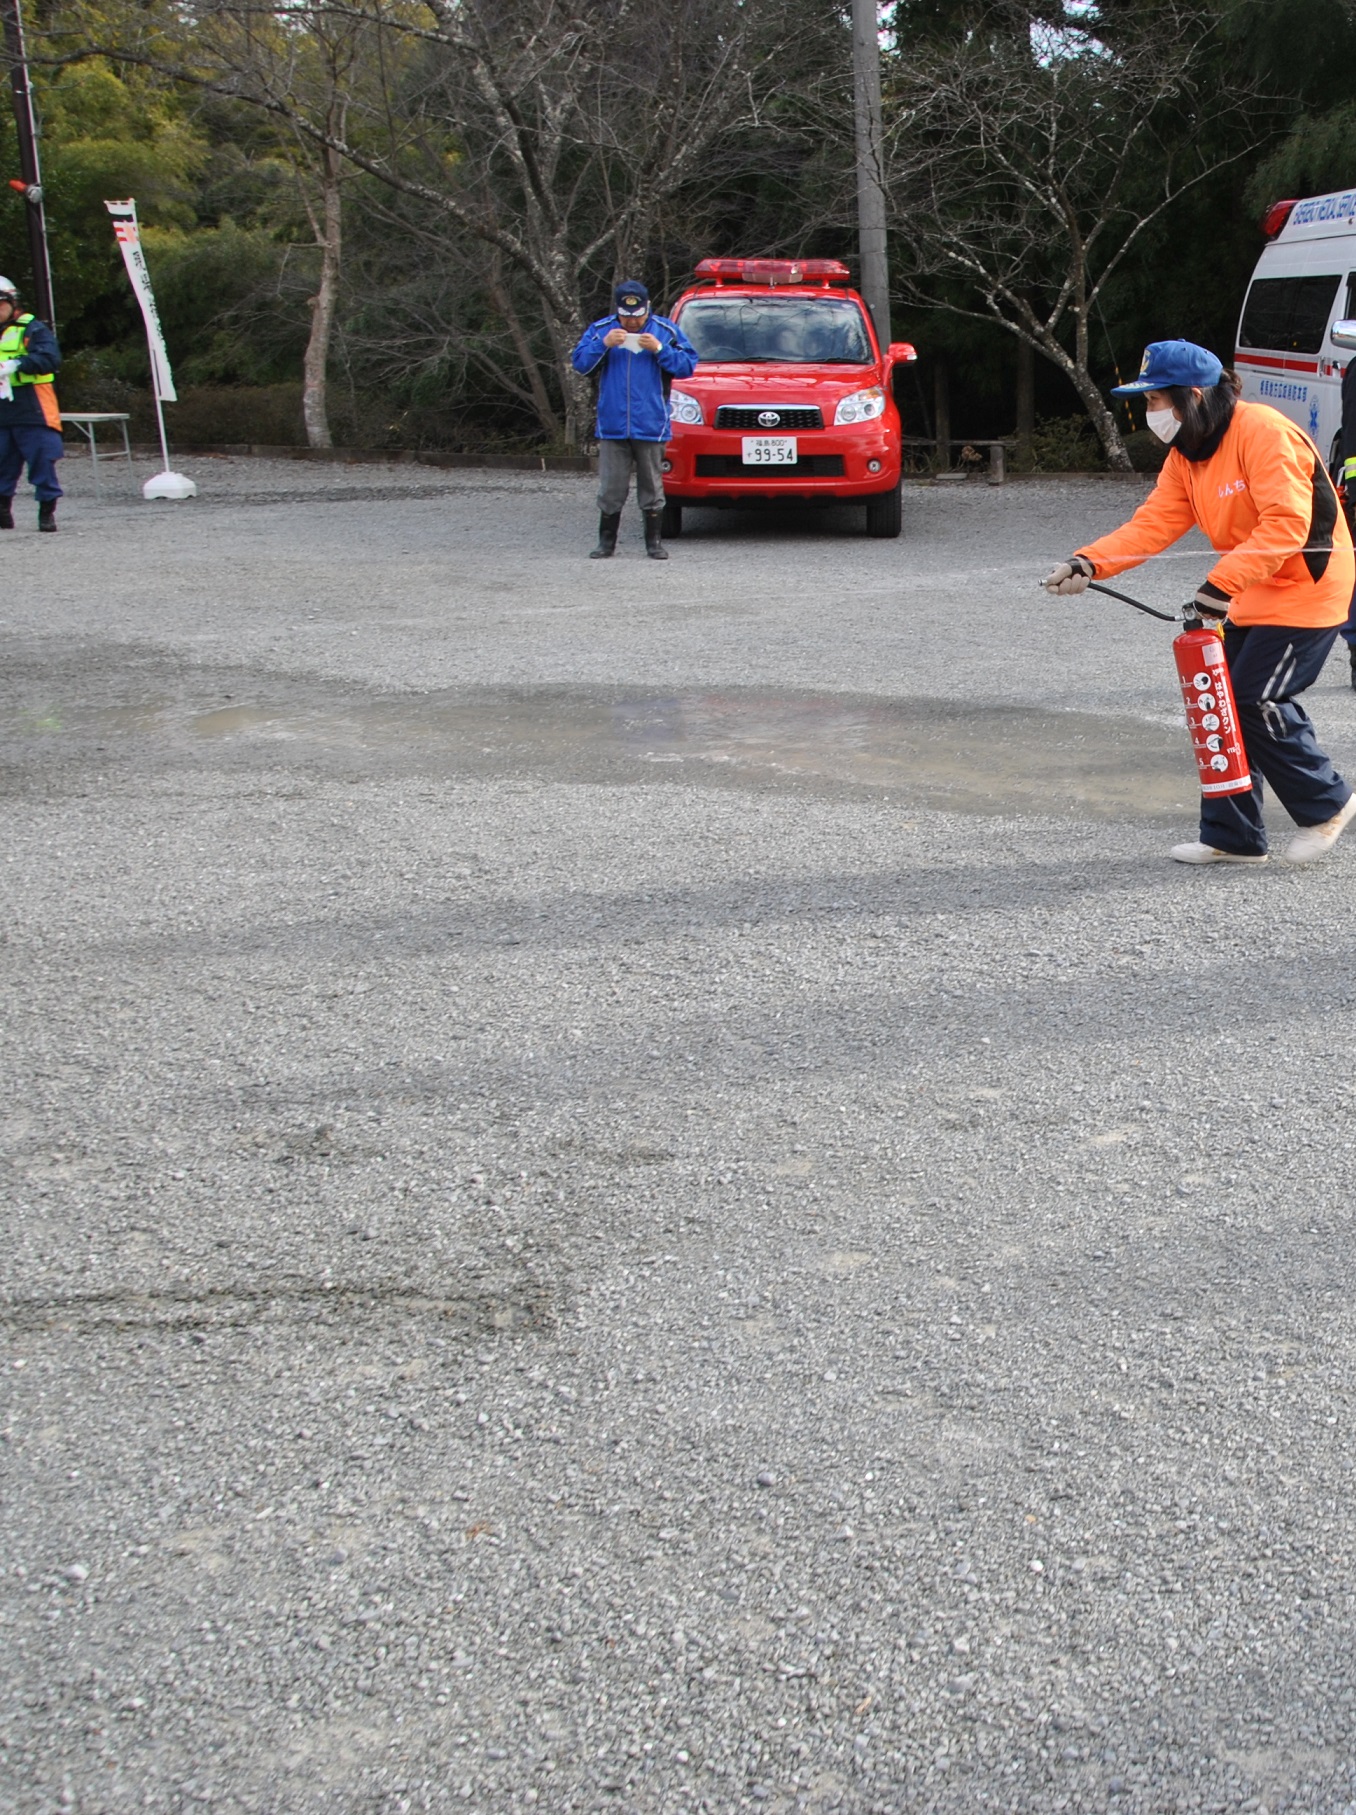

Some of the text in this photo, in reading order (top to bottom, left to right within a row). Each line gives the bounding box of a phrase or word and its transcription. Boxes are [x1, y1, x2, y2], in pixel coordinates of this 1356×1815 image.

[754, 448, 794, 462] 99-54
[1217, 479, 1247, 498] しんち
